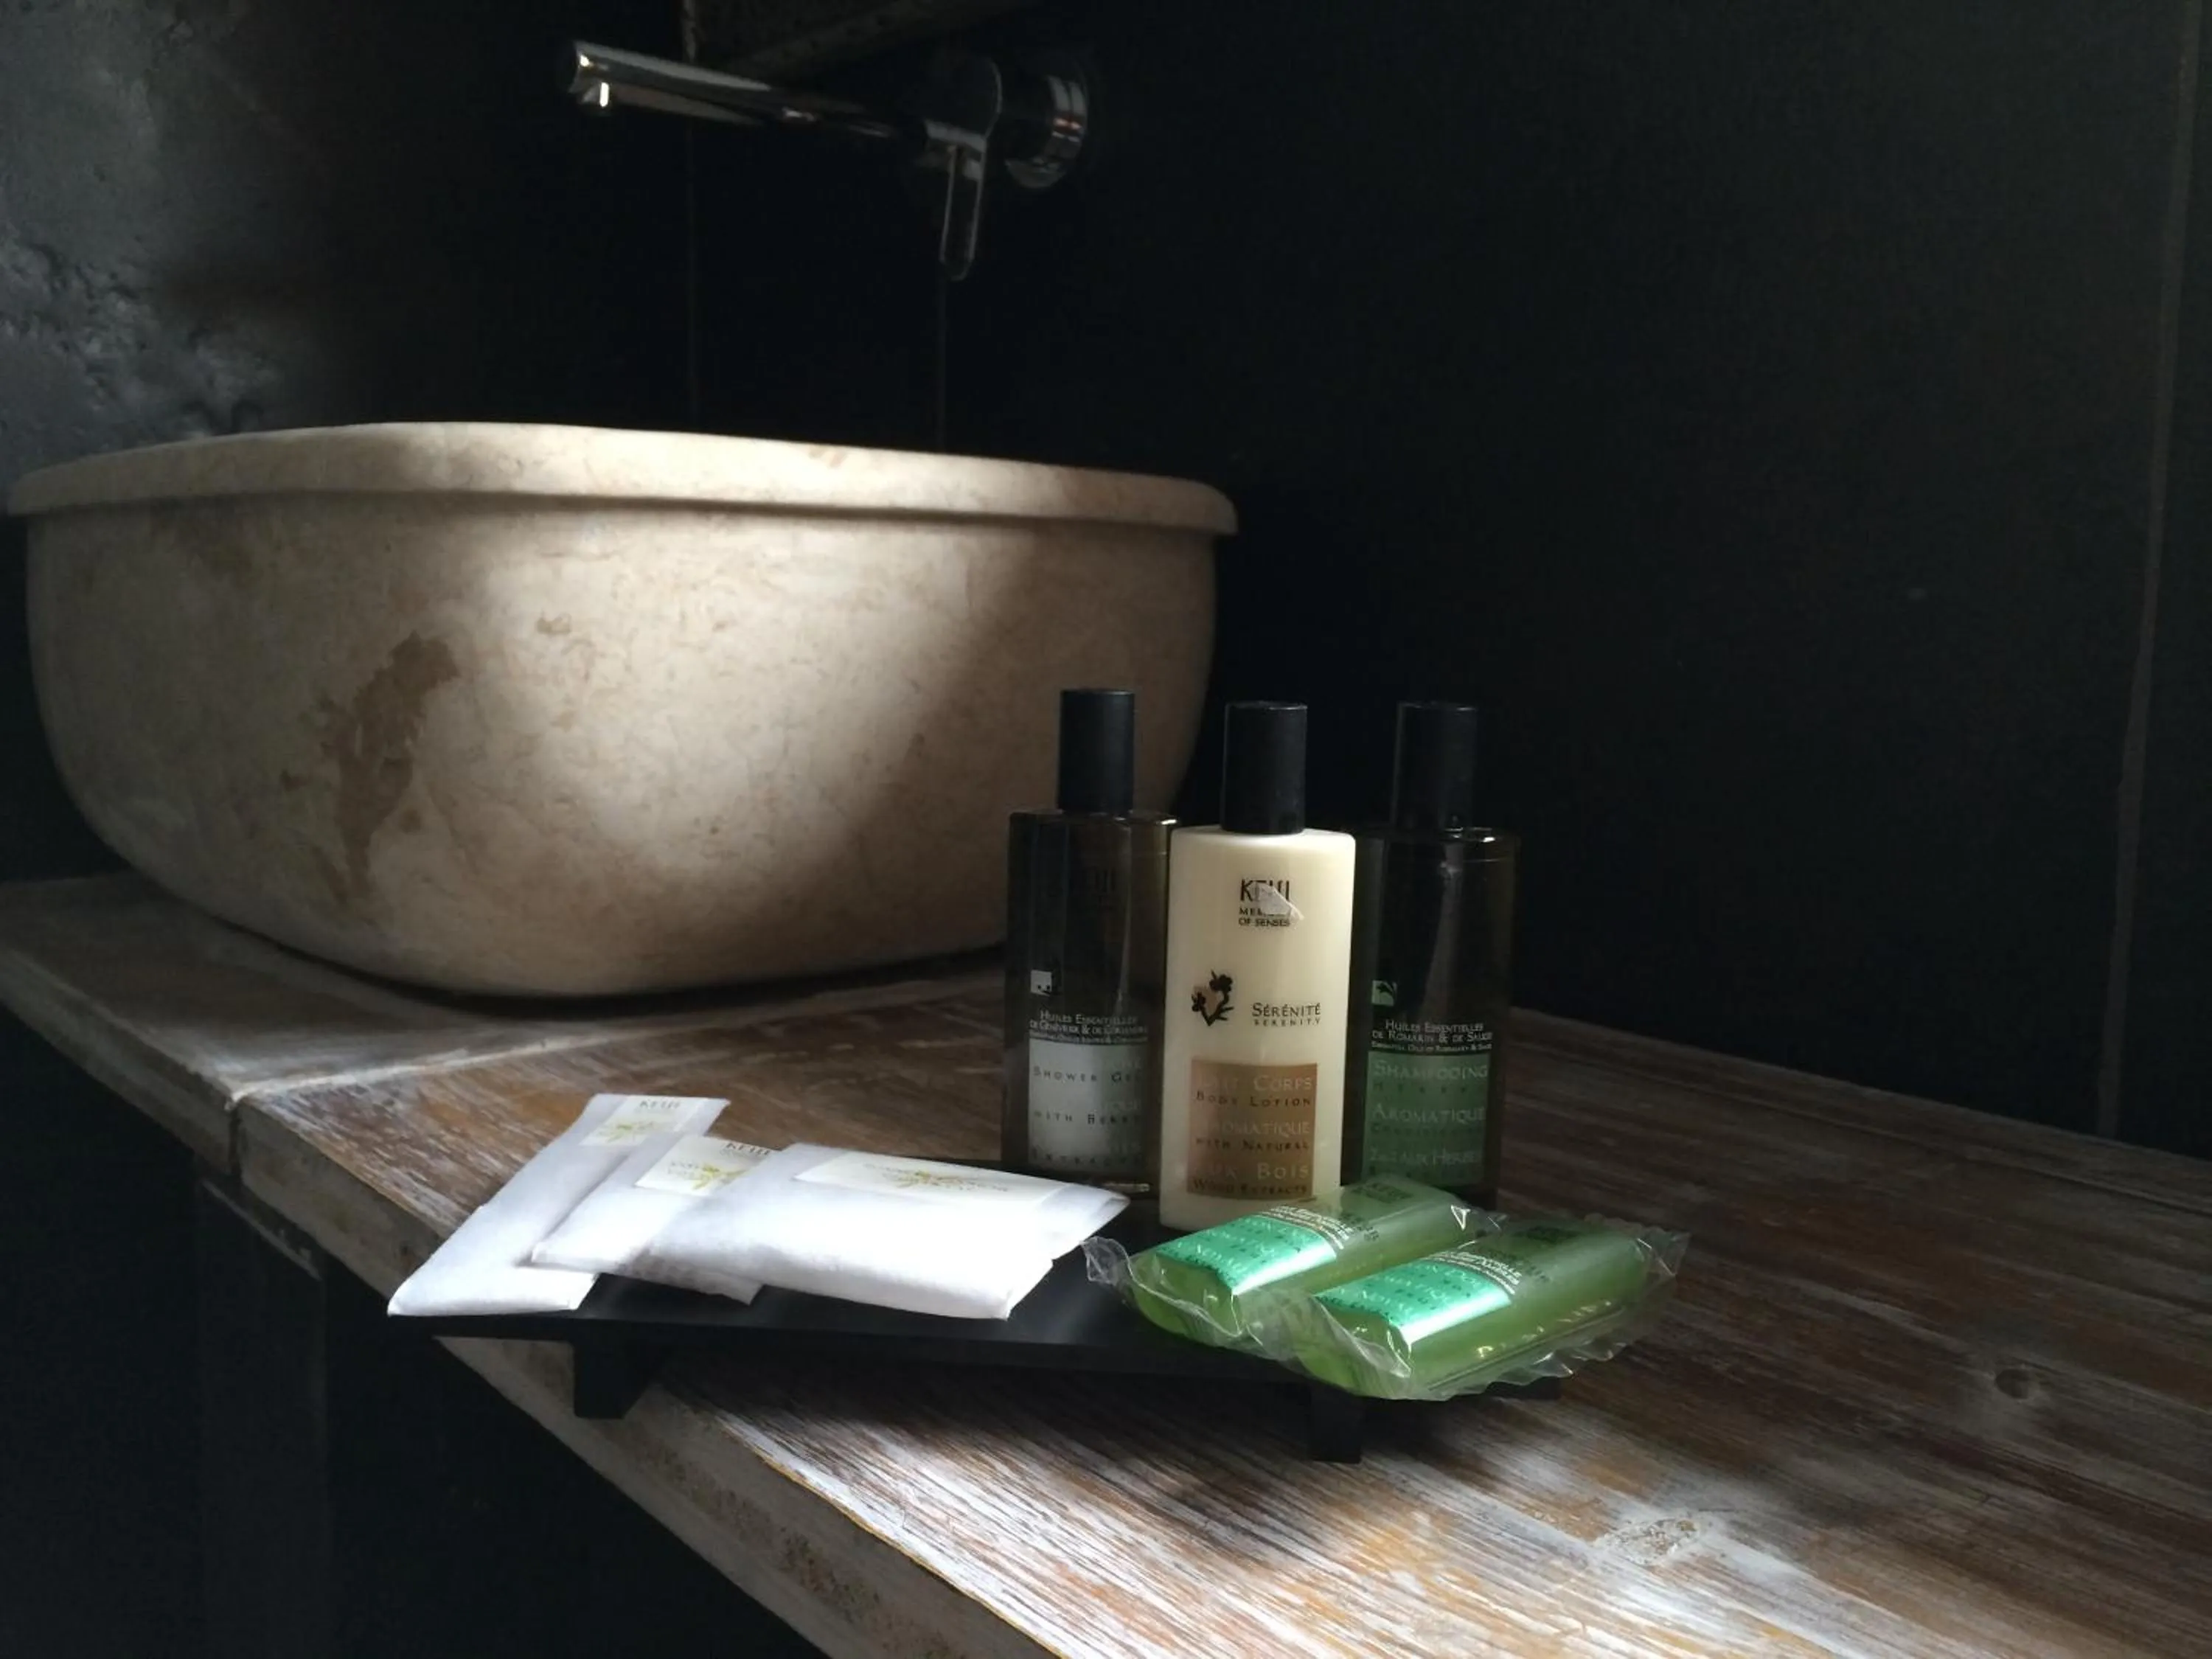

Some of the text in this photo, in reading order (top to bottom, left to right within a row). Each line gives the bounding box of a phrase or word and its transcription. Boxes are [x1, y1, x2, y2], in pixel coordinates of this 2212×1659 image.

[1239, 917, 1290, 928] OF SENSES
[1252, 1002, 1321, 1018] SÉRÉNITÉ
[1253, 1018, 1321, 1027] SERENITY
[1032, 1065, 1097, 1083] SHOWER
[1254, 1074, 1312, 1092] CORPS
[1196, 1089, 1311, 1107] BODY LOTION
[1256, 1161, 1310, 1181] BOIS
